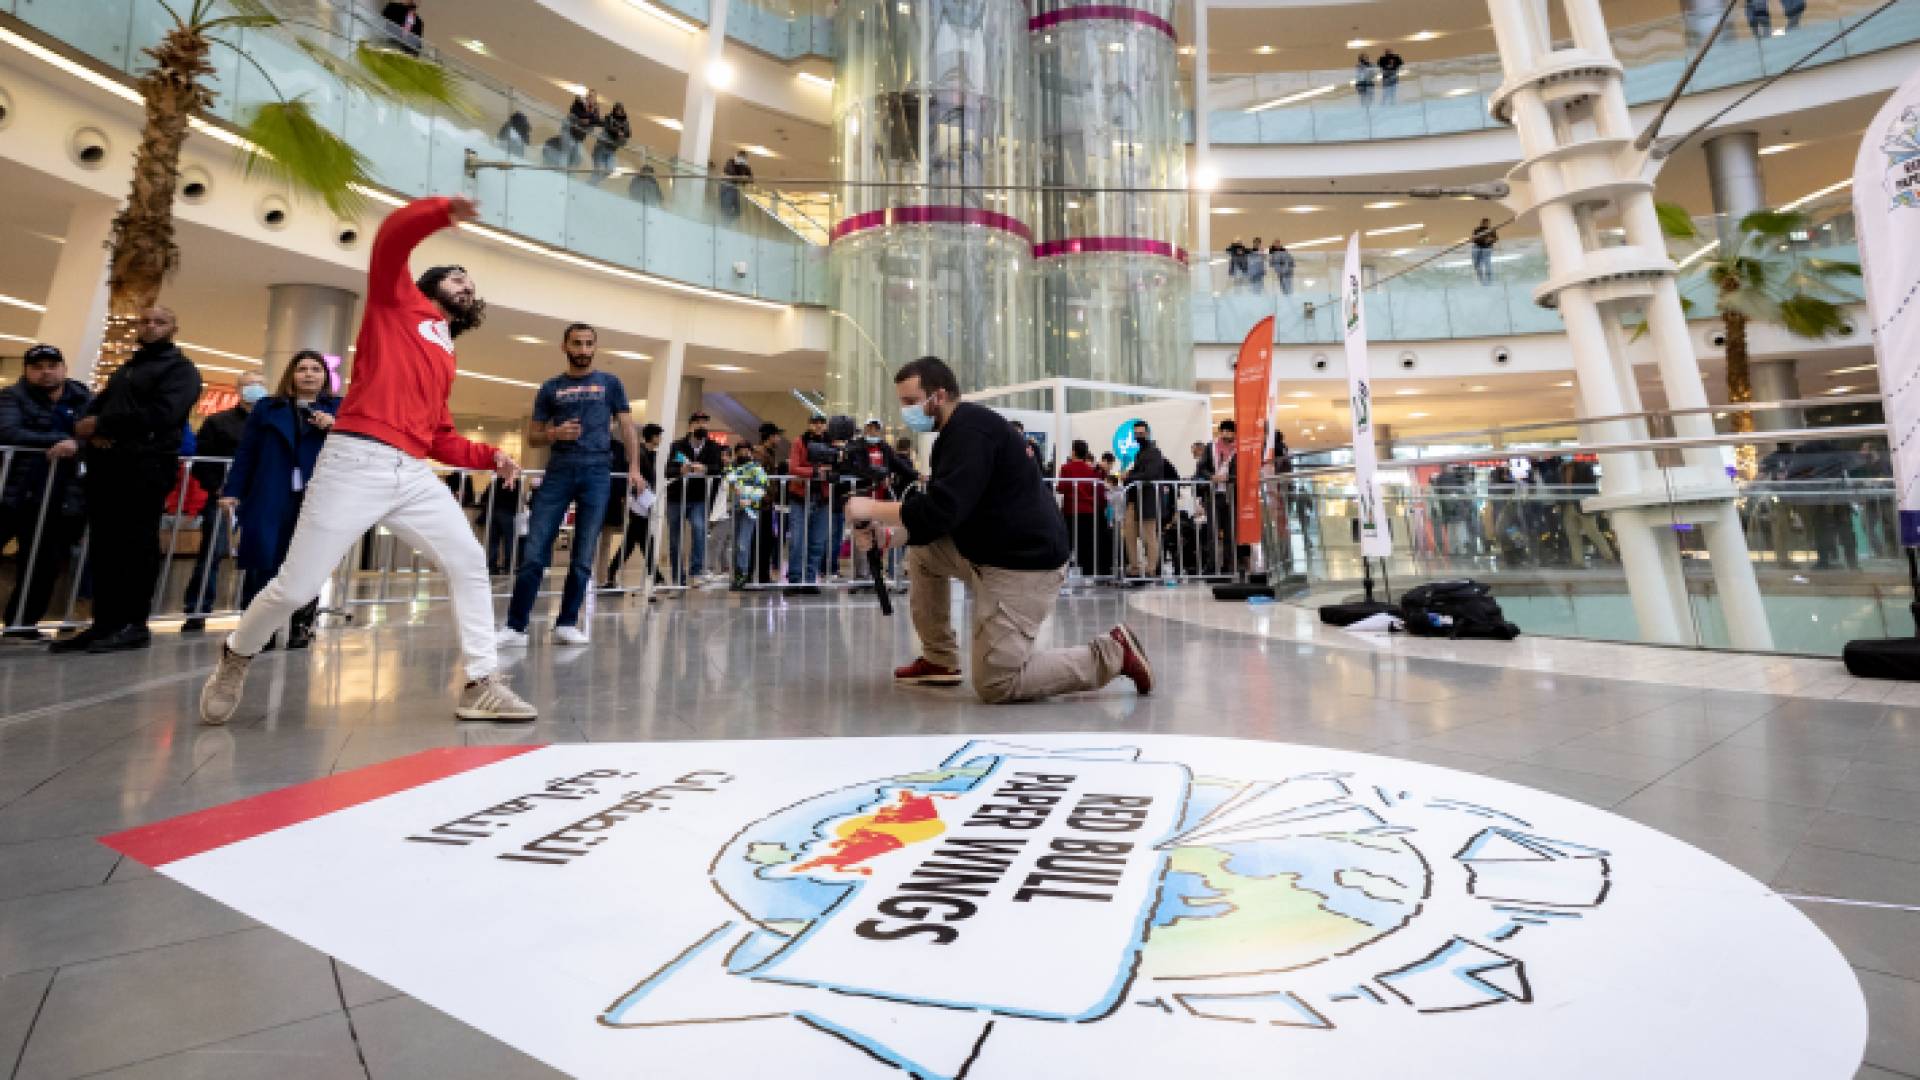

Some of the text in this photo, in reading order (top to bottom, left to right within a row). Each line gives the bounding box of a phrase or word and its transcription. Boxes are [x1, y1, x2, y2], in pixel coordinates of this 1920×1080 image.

[404, 768, 639, 846] النهائية
[495, 769, 735, 865] التصفيات
[854, 771, 1077, 946] PAPER WINGS
[1012, 792, 1152, 903] RED BULL
